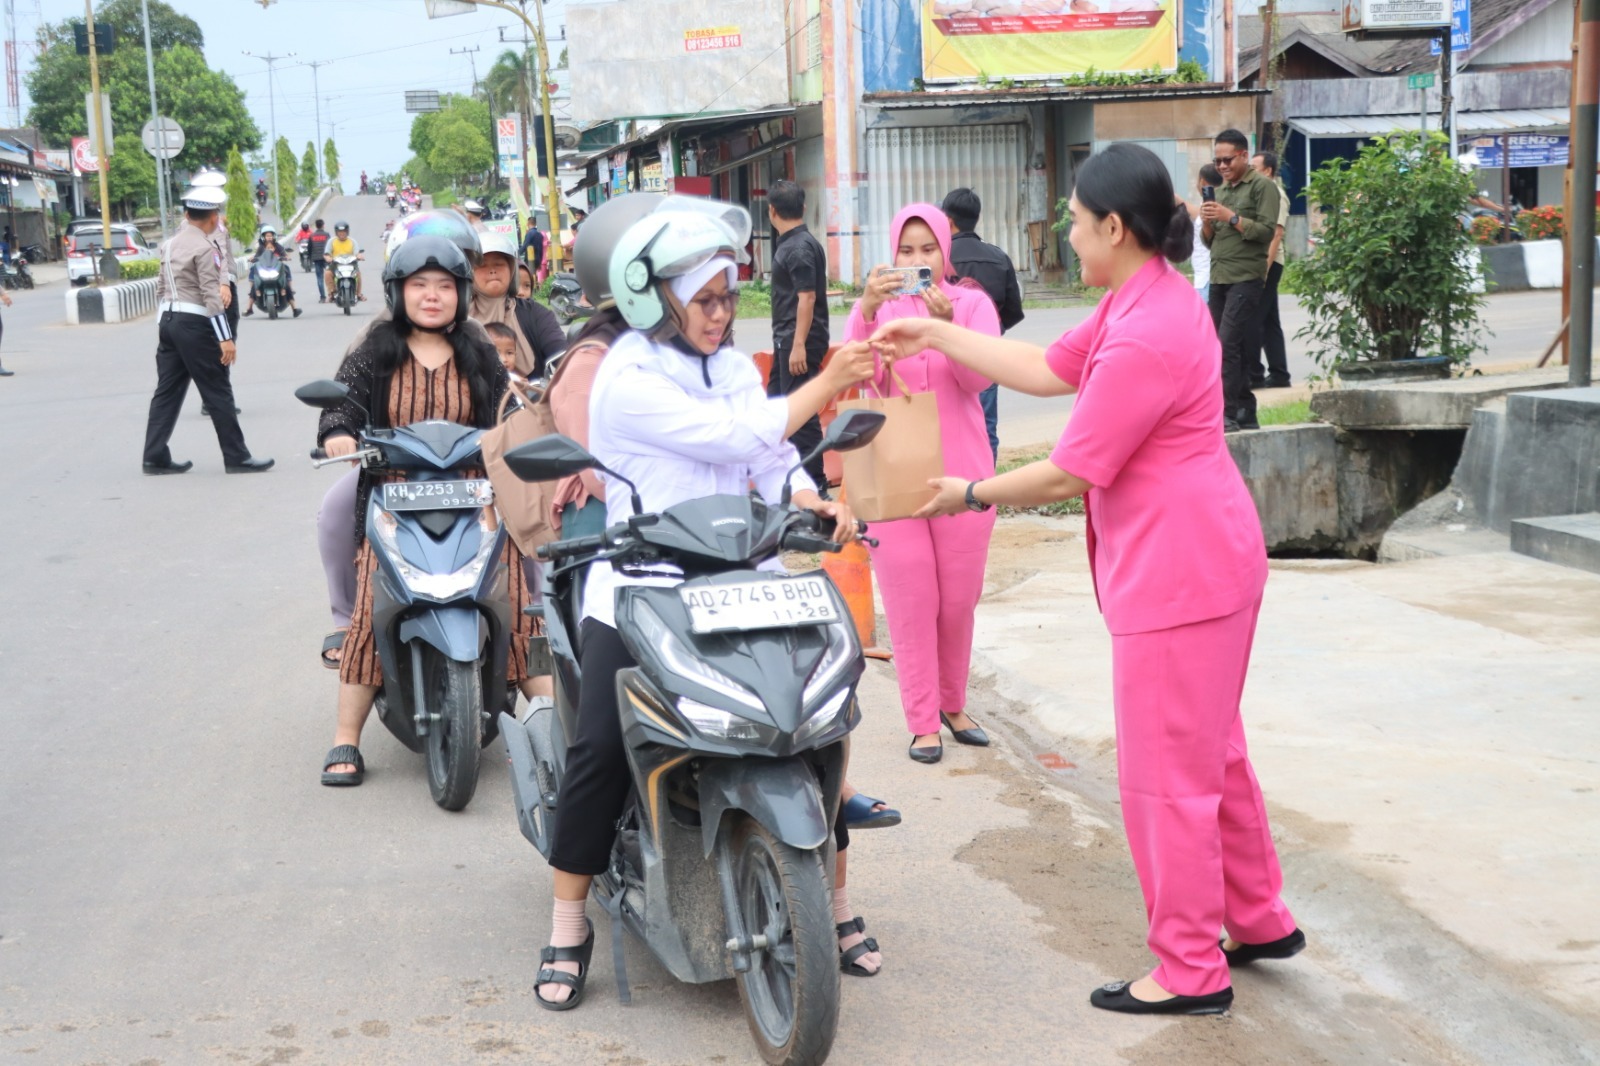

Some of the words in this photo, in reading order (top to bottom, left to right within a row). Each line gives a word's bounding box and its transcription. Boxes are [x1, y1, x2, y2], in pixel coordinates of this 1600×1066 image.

[686, 30, 716, 38] TOBASA
[500, 137, 515, 145] BNI
[388, 485, 408, 498] KH
[415, 483, 455, 497] 2253
[711, 517, 747, 527] HONDA
[688, 591, 716, 610] AD
[718, 585, 776, 606] 2746
[781, 581, 823, 600] BHD
